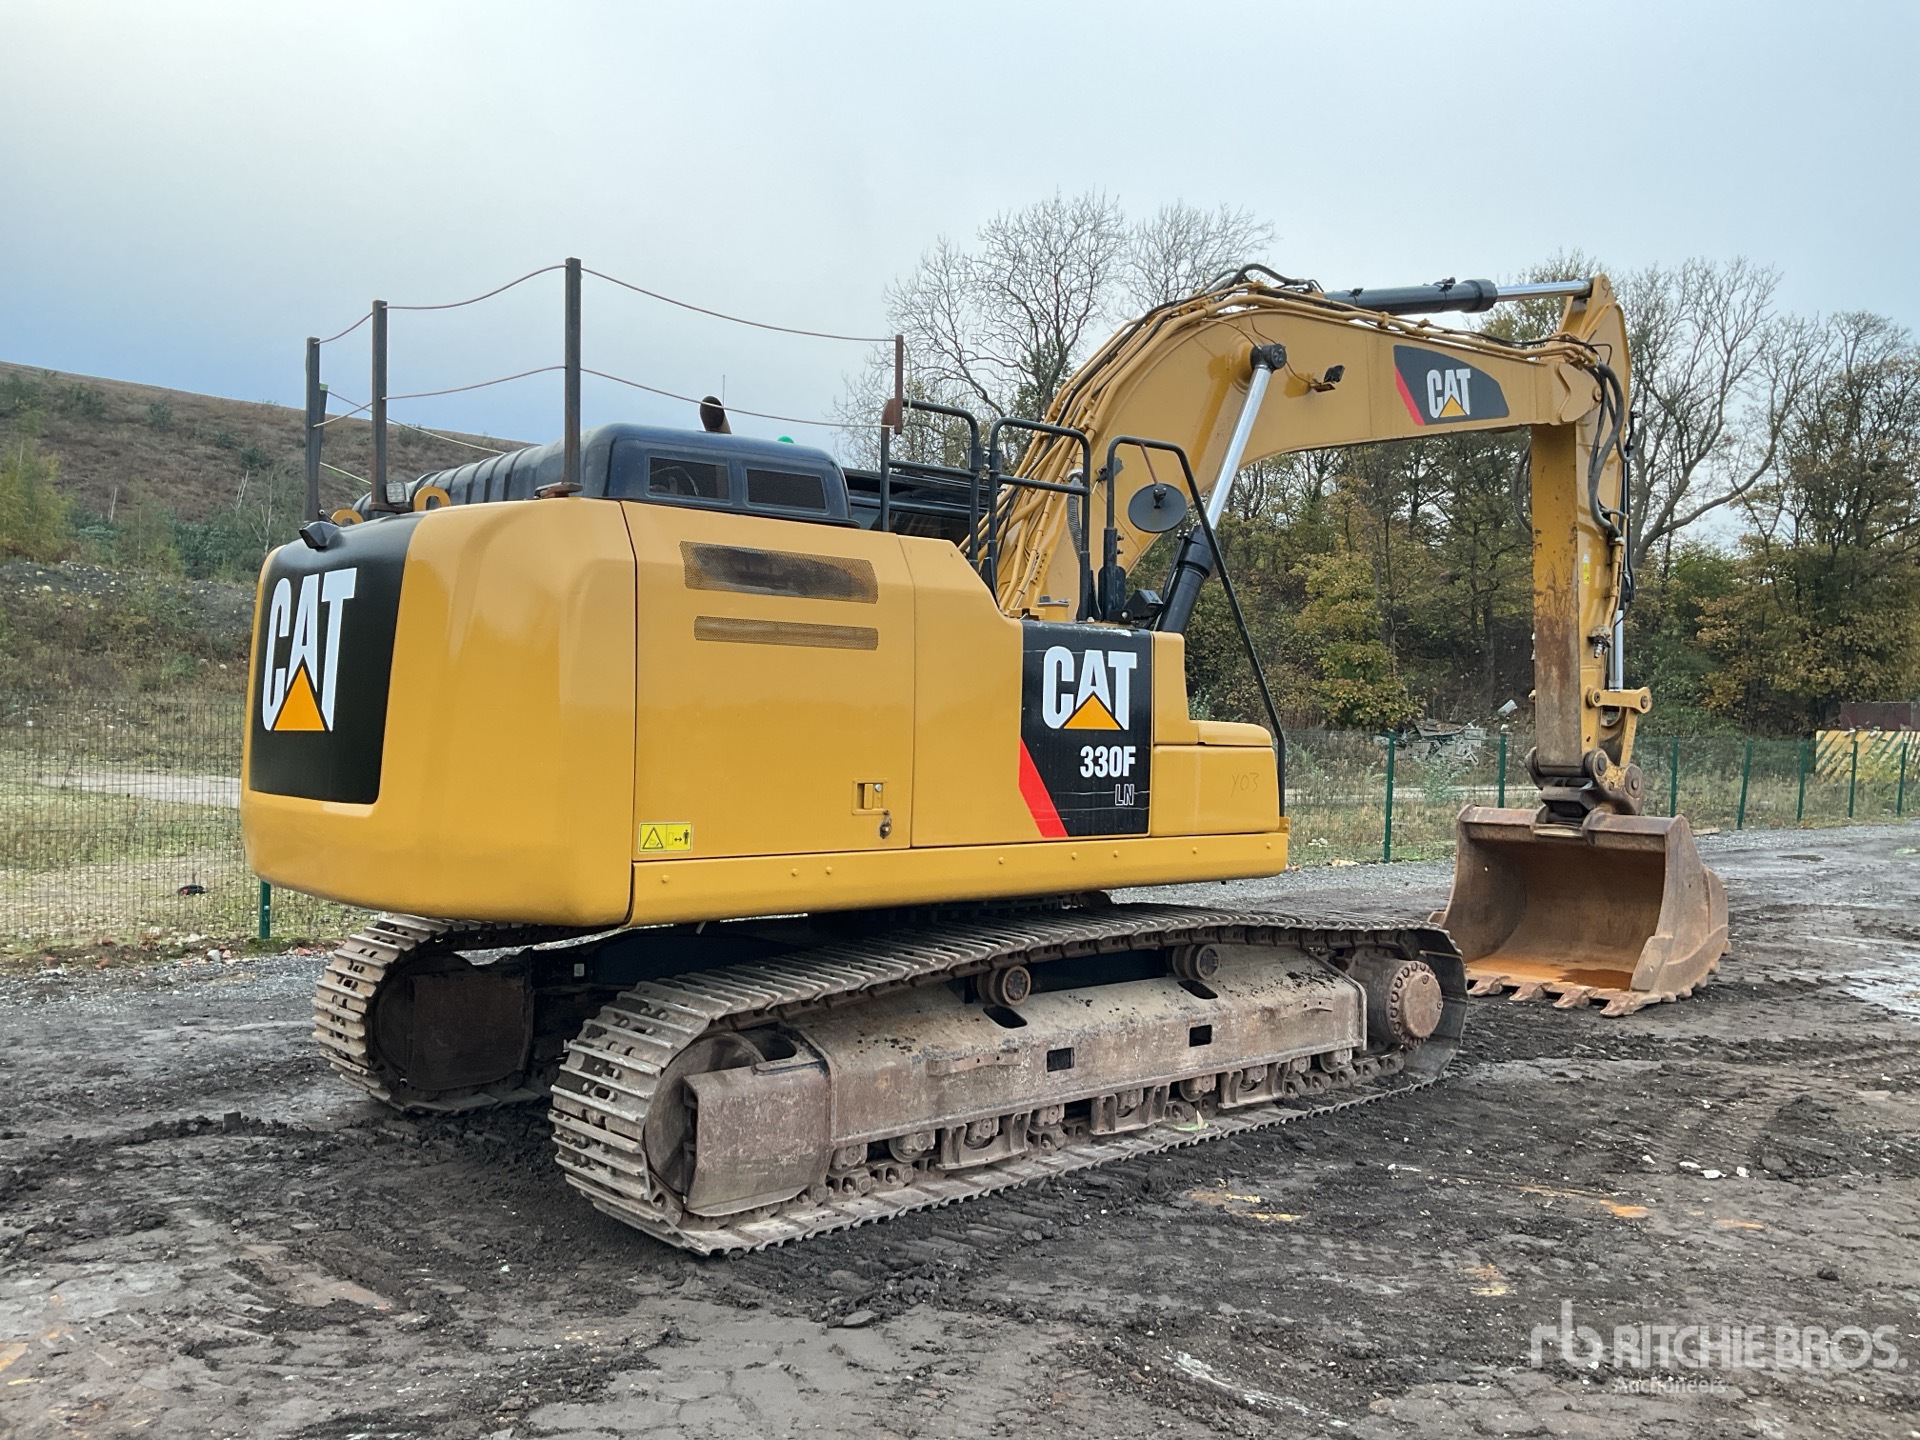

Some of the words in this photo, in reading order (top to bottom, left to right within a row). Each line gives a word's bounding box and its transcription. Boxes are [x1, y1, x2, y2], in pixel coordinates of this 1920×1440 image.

[1426, 368, 1471, 419] CAT
[262, 567, 357, 732] CAT
[1042, 645, 1137, 730] CAT
[1080, 745, 1136, 778] 330F
[1114, 783, 1135, 806] LN
